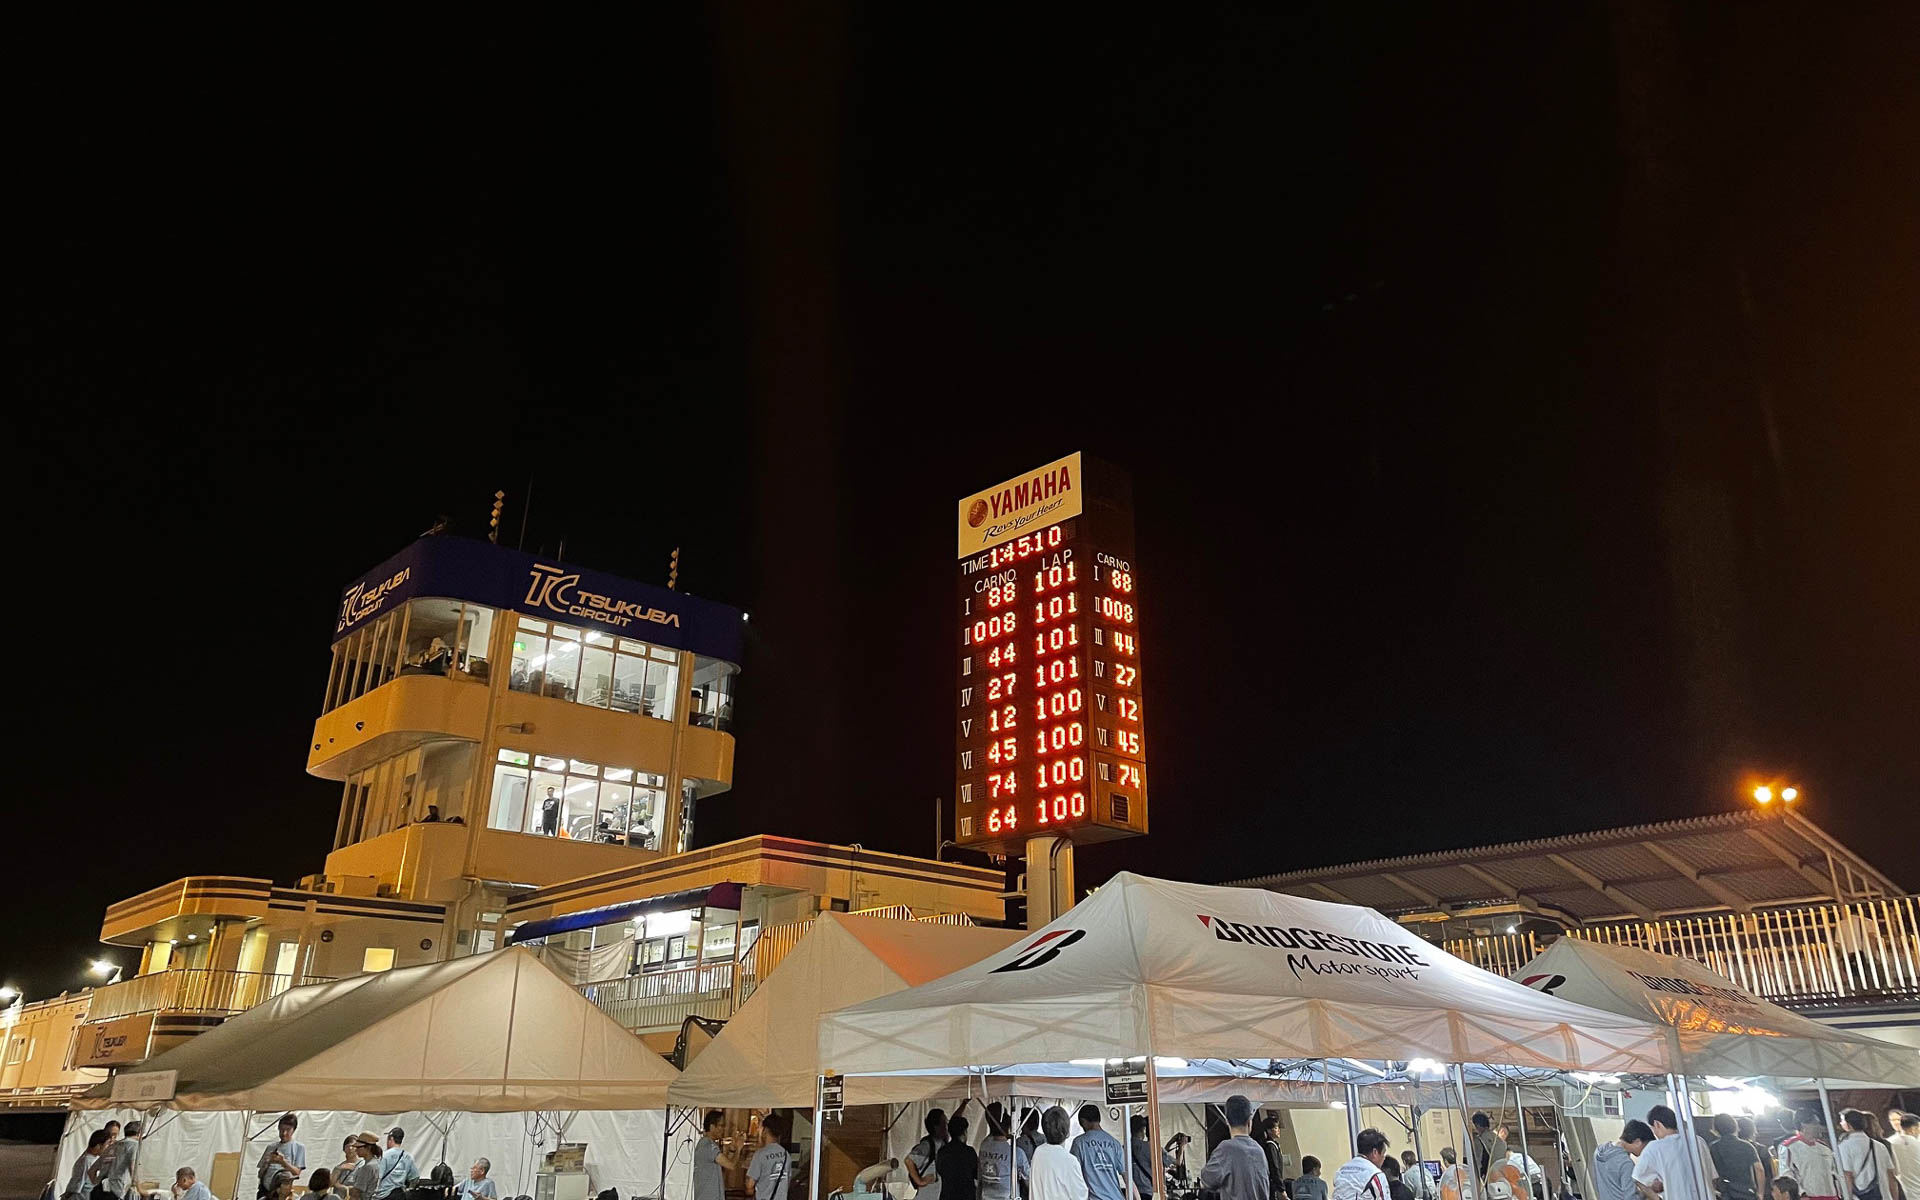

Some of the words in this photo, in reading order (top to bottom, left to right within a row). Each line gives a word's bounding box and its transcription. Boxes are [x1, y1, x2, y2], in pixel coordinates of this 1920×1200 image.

[990, 466, 1071, 519] YAMAHA
[983, 519, 1014, 543] Revs
[1014, 511, 1036, 530] Your
[1036, 499, 1063, 517] Heart
[961, 554, 989, 575] TIME
[1042, 549, 1072, 571] LAP
[989, 582, 1015, 607] 88
[1036, 561, 1076, 592] 101
[1112, 569, 1132, 592] 88
[577, 590, 680, 629] TSUKUBA
[974, 612, 1015, 642] 008
[1036, 592, 1077, 623] 101
[1103, 597, 1133, 623] 008
[989, 642, 1016, 667] 44
[1037, 624, 1078, 655] 101
[1115, 632, 1134, 655] 44
[989, 673, 1016, 700] 27
[1037, 656, 1078, 687] 101
[1116, 663, 1136, 687] 27
[961, 719, 972, 738] V
[990, 706, 1016, 732] 12
[1037, 689, 1081, 720] 100
[1096, 694, 1105, 711] V
[1119, 697, 1138, 721] 12
[989, 738, 1016, 763] 45
[1038, 723, 1082, 753] 100
[1119, 730, 1139, 754] 45
[989, 771, 1016, 798] 74
[1038, 757, 1083, 788] 100
[1120, 765, 1140, 789] 74
[990, 805, 1017, 832] 64
[1038, 793, 1084, 823] 100
[1198, 914, 1430, 967] BRIDGESTONE
[1286, 953, 1420, 983] Motorsport
